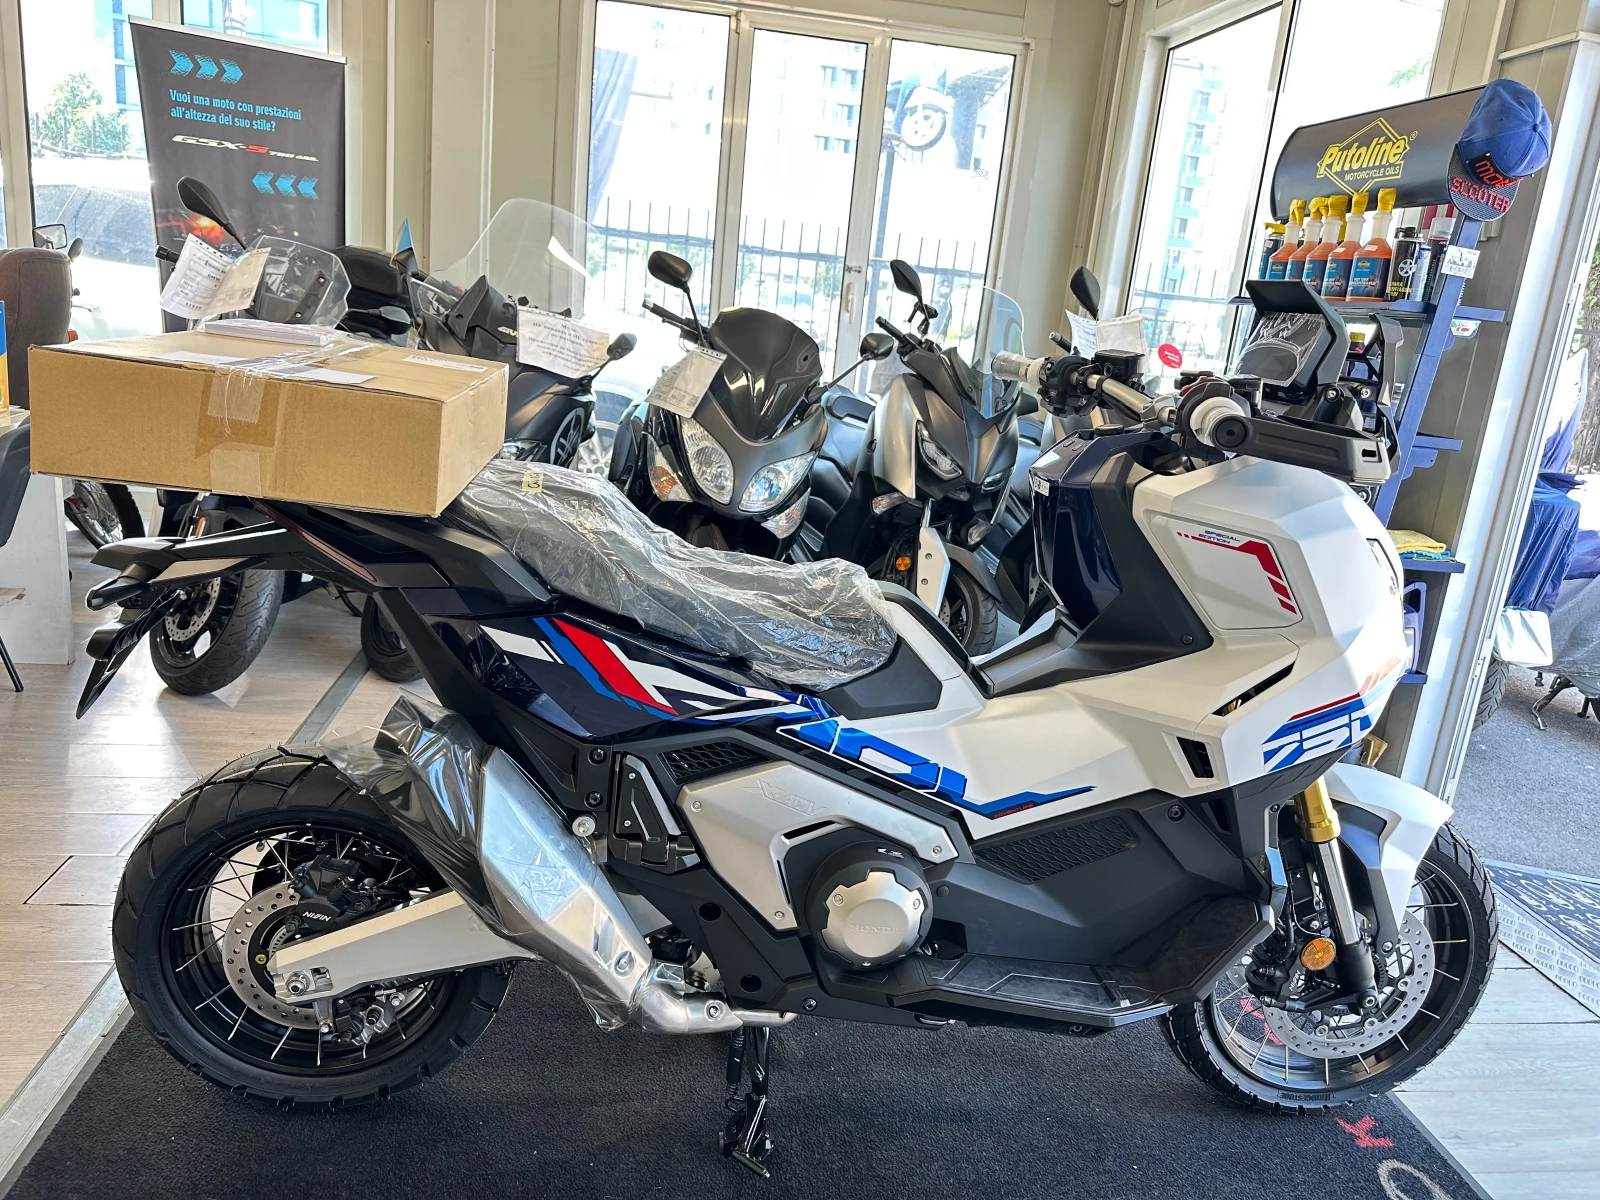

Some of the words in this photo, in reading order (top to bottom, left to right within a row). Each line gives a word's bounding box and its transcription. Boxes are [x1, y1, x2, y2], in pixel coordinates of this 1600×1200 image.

[170, 89, 190, 103] Vuoi
[193, 95, 210, 106] una
[212, 98, 235, 110] moto
[237, 102, 253, 113] con
[256, 105, 301, 120] prestazioni
[171, 107, 216, 123] all'altezza
[219, 113, 232, 125] del
[235, 117, 250, 128] suo
[252, 119, 276, 131] stile?
[172, 135, 269, 153] GSX-S
[1320, 136, 1407, 174] Putoline
[1344, 168, 1384, 181] MOTORCYCLE
[1385, 166, 1400, 176] OILS
[1450, 176, 1511, 212] SCOOTER
[1198, 533, 1230, 544] EDITION
[1204, 530, 1240, 542] SPECIAL
[994, 803, 1033, 819] ADVENTURE
[849, 924, 905, 934] HONDA
